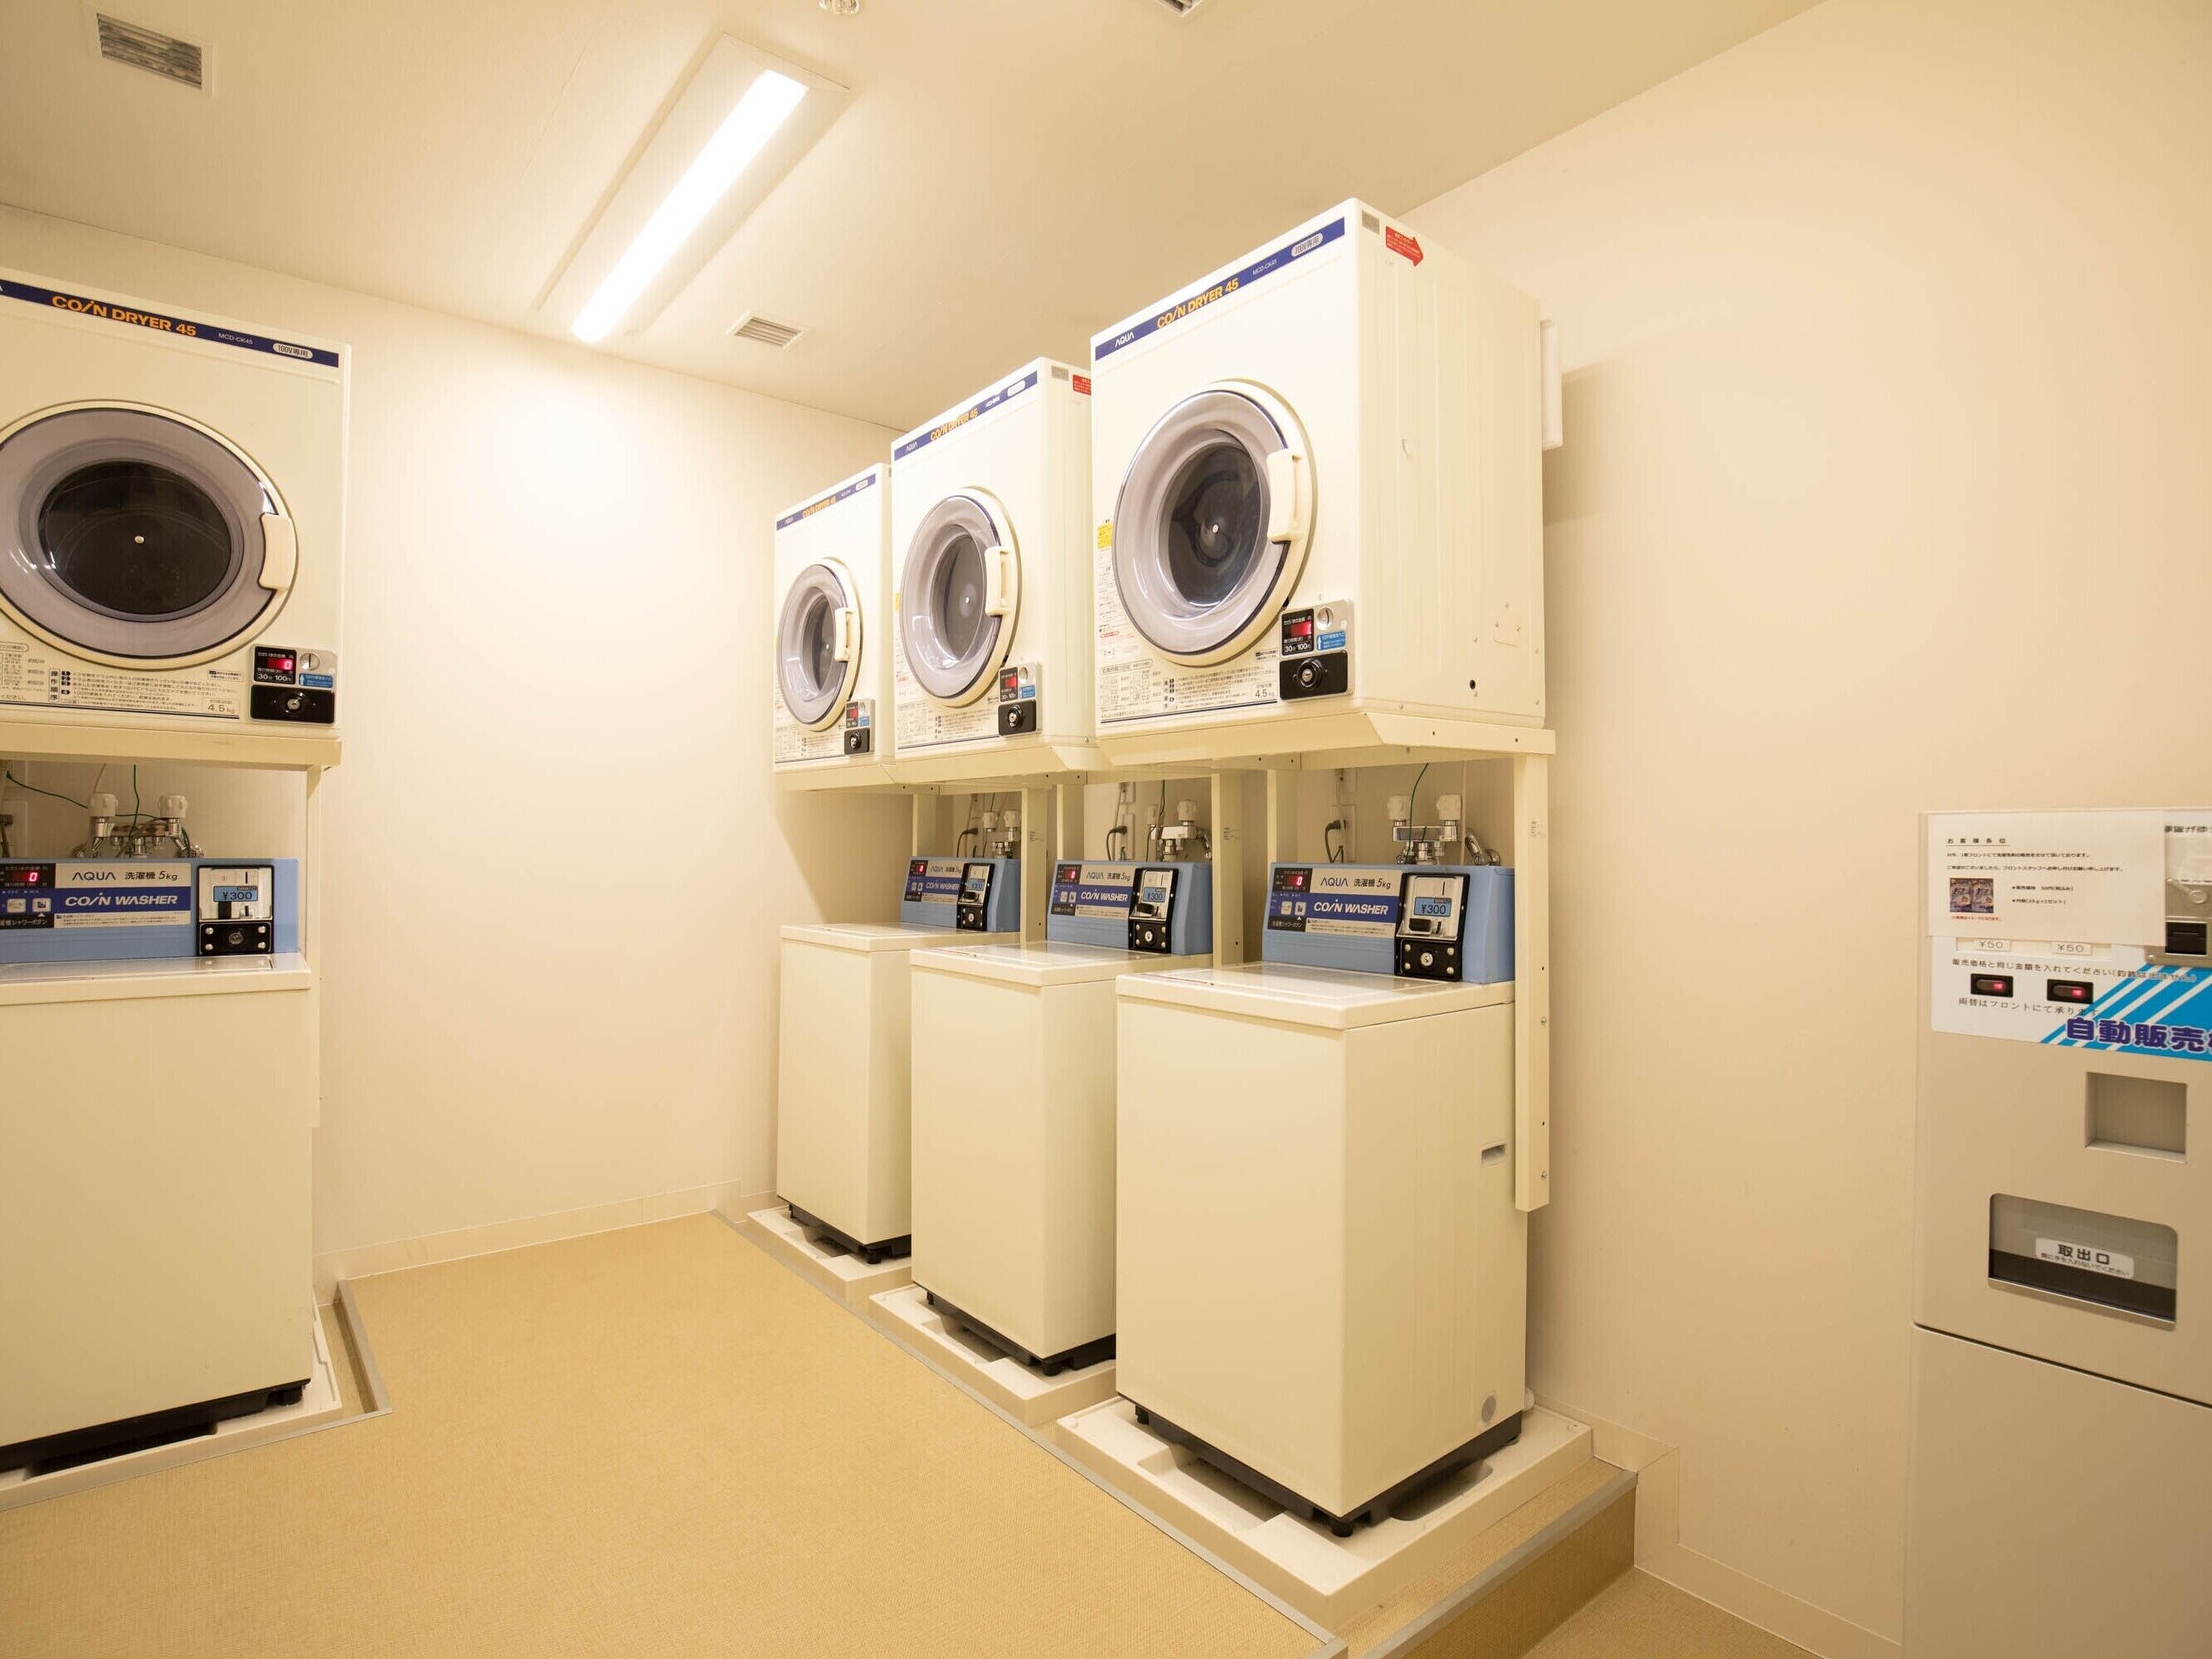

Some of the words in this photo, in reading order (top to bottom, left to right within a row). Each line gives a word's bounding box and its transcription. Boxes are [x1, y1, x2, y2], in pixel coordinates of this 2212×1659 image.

[1157, 304, 1186, 328] COIN
[1188, 286, 1223, 313] DRYER
[1225, 278, 1239, 292] 45
[51, 295, 107, 318] COIN
[112, 309, 171, 331] DRYER
[176, 322, 197, 336] 45
[1116, 332, 1135, 347] AQUA
[29, 872, 38, 882] 0
[72, 872, 116, 881] AQUA
[124, 871, 156, 880] 洗濯機
[158, 871, 178, 881] 5kg
[1296, 876, 1303, 885] 0
[1320, 877, 1349, 887] AQUA
[1354, 878, 1375, 888] 洗濯機
[1376, 878, 1392, 889] 5kg
[65, 893, 111, 907] COIN
[115, 895, 178, 906] WASHER
[222, 891, 253, 900] ¥300
[1101, 893, 1128, 902] WASHER
[1314, 898, 1343, 912] COIN
[1344, 903, 1389, 915] WASHER
[1421, 904, 1446, 914] ¥300
[1979, 941, 2004, 949] ¥50
[2058, 943, 2084, 952] ¥50
[2067, 1017, 2212, 1053] 自動販売
[2058, 1243, 2110, 1265] 取出口
